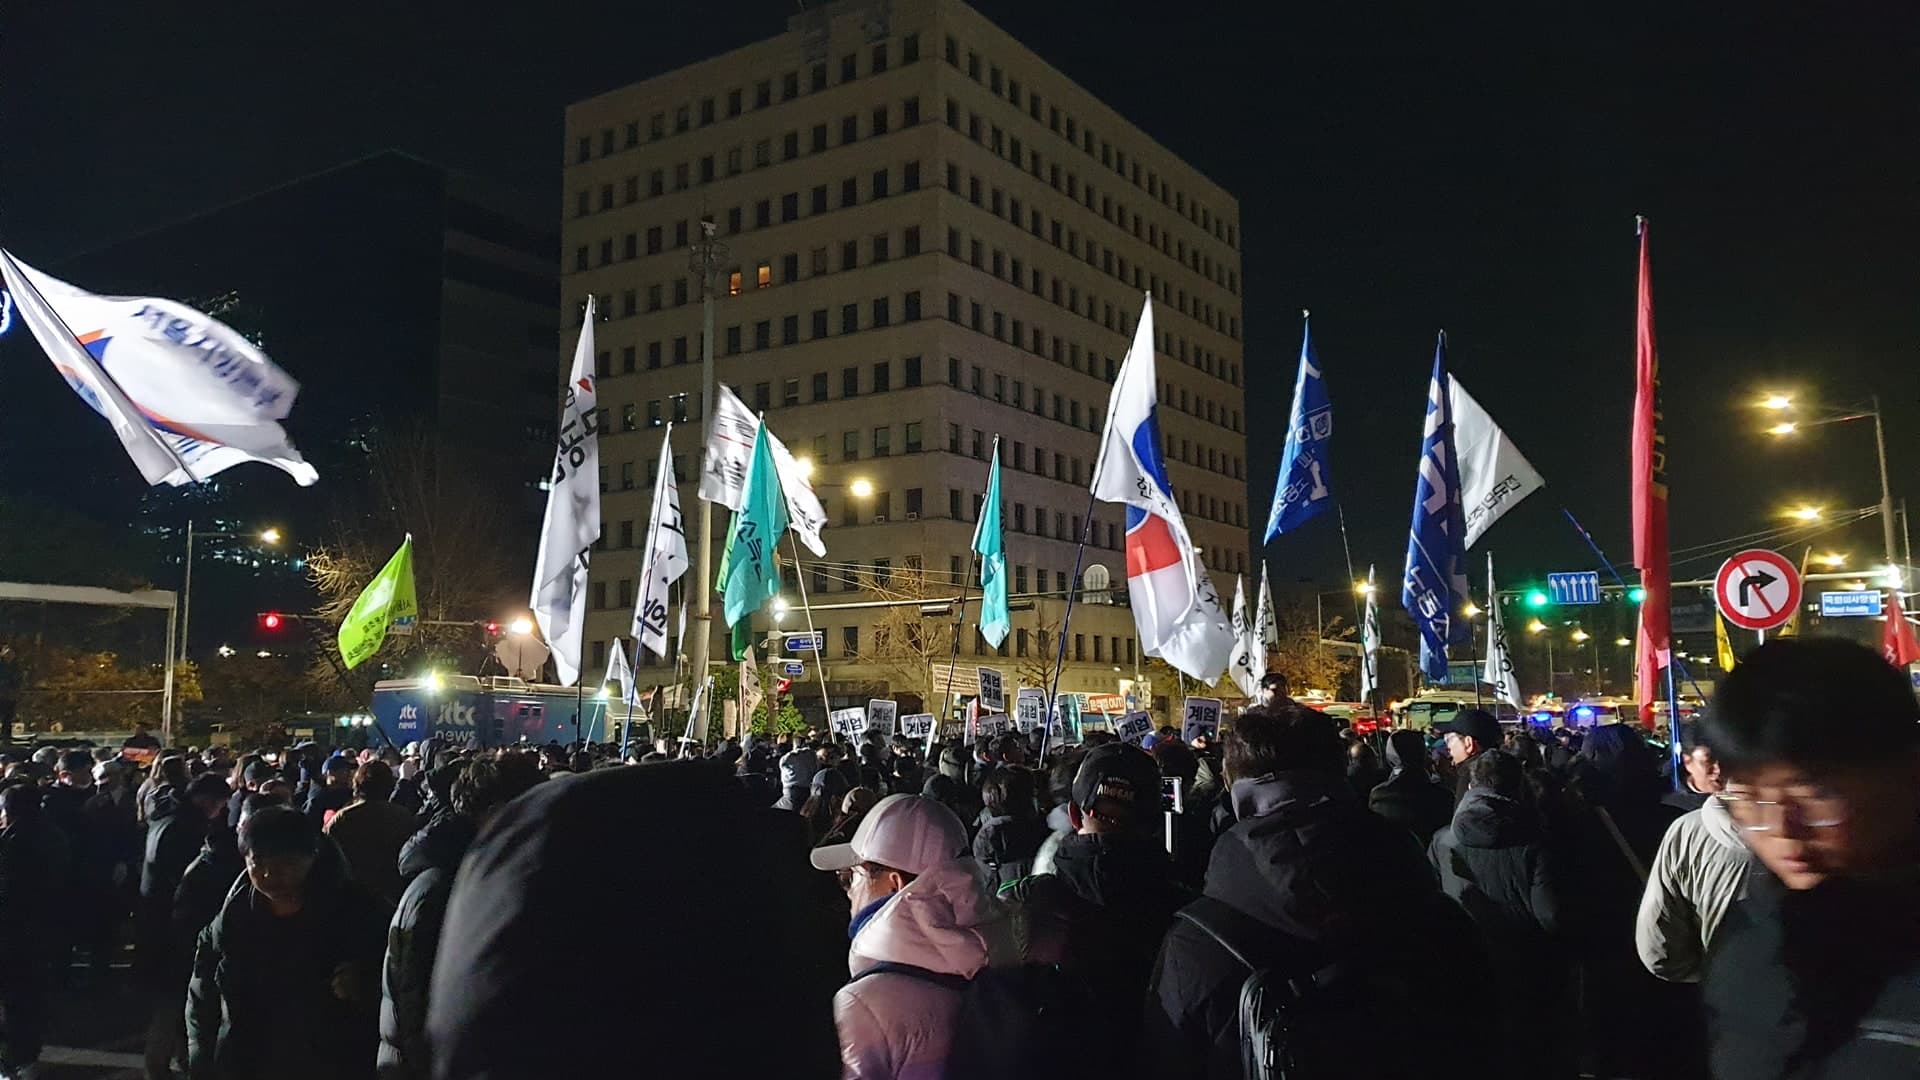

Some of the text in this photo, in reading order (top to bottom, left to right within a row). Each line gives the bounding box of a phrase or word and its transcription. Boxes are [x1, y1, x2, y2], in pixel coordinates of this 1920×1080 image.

[982, 673, 1001, 688] 계엄
[1188, 706, 1217, 722] 계엄
[837, 717, 863, 733] 계엄
[907, 720, 931, 735] 계엄
[1121, 716, 1149, 737] 계엄
[435, 730, 476, 742] news
